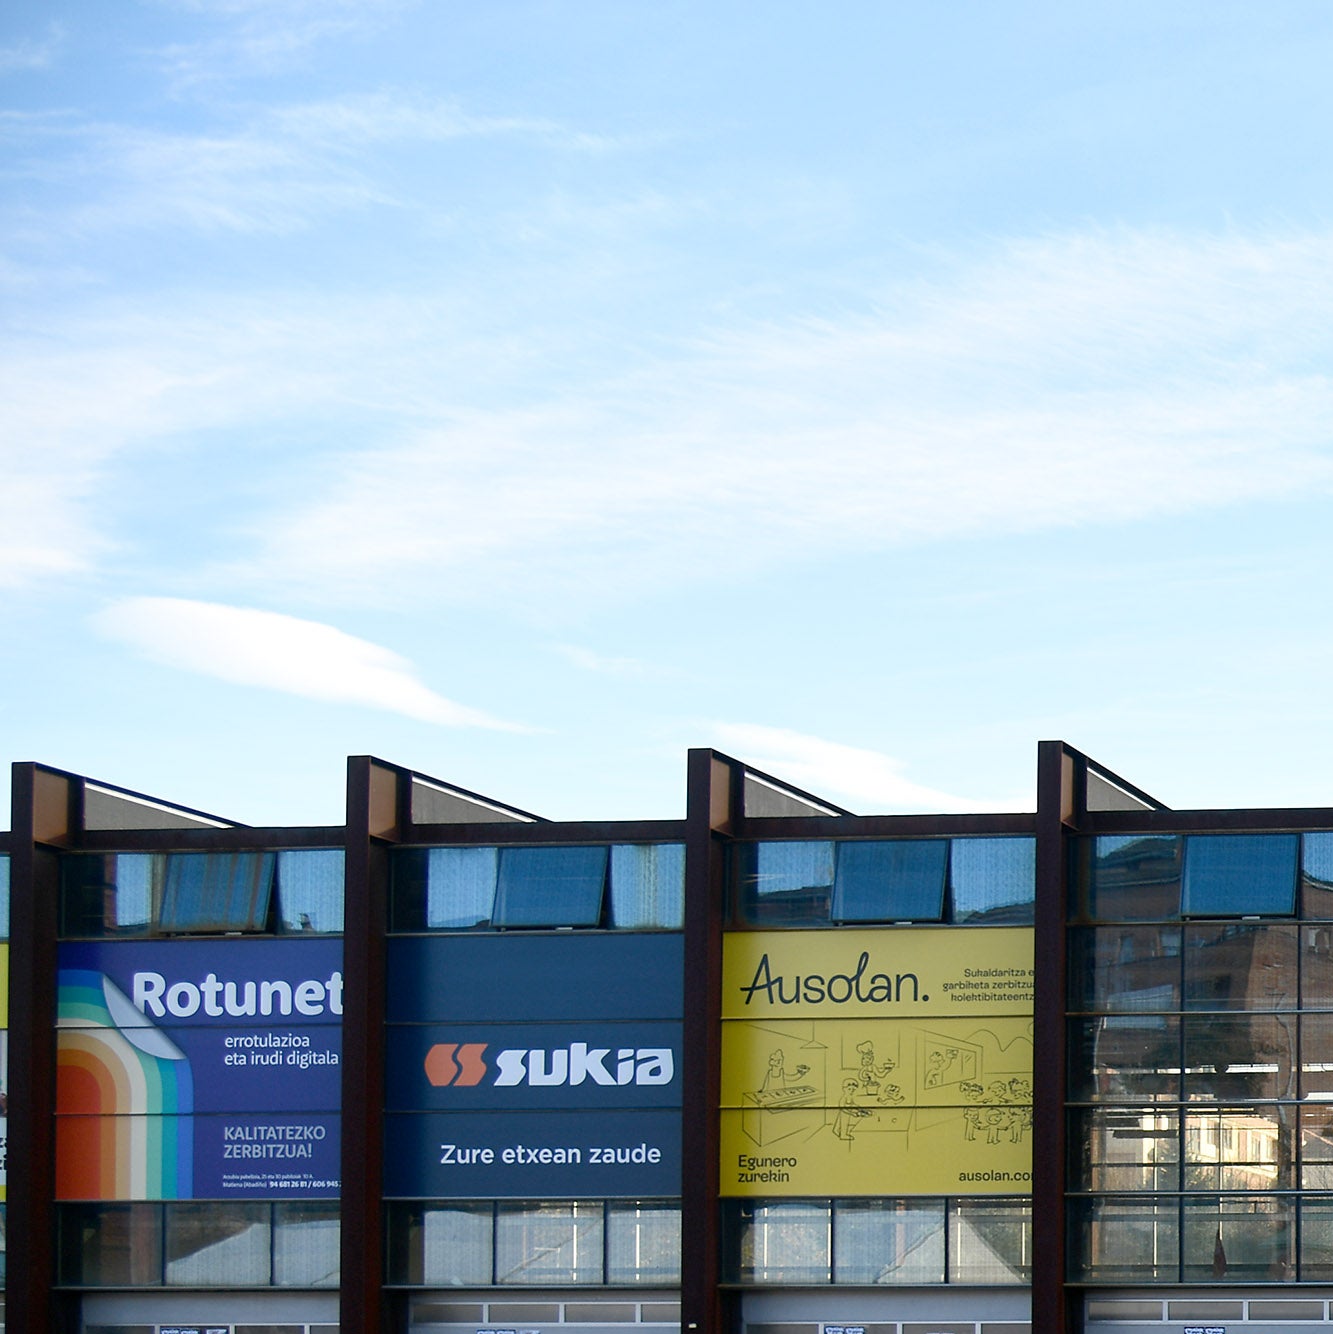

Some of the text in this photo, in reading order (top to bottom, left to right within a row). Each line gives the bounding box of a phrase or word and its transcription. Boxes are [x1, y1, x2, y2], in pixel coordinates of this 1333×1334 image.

[740, 951, 929, 1005] Ausolan.
[964, 968, 1026, 977] Sukaldaritza
[943, 981, 989, 992] garbiketa
[133, 972, 343, 1018] Rotunet
[225, 1033, 310, 1048] errotulazioa
[225, 1051, 338, 1069] eta irudi digitala
[224, 1126, 325, 1140] KALITATEZKO
[224, 1144, 312, 1158] ZERBITZUA!
[440, 1143, 661, 1164] Zure etxean zaude
[738, 1154, 797, 1171] Egunero
[738, 1171, 790, 1183] zurekin
